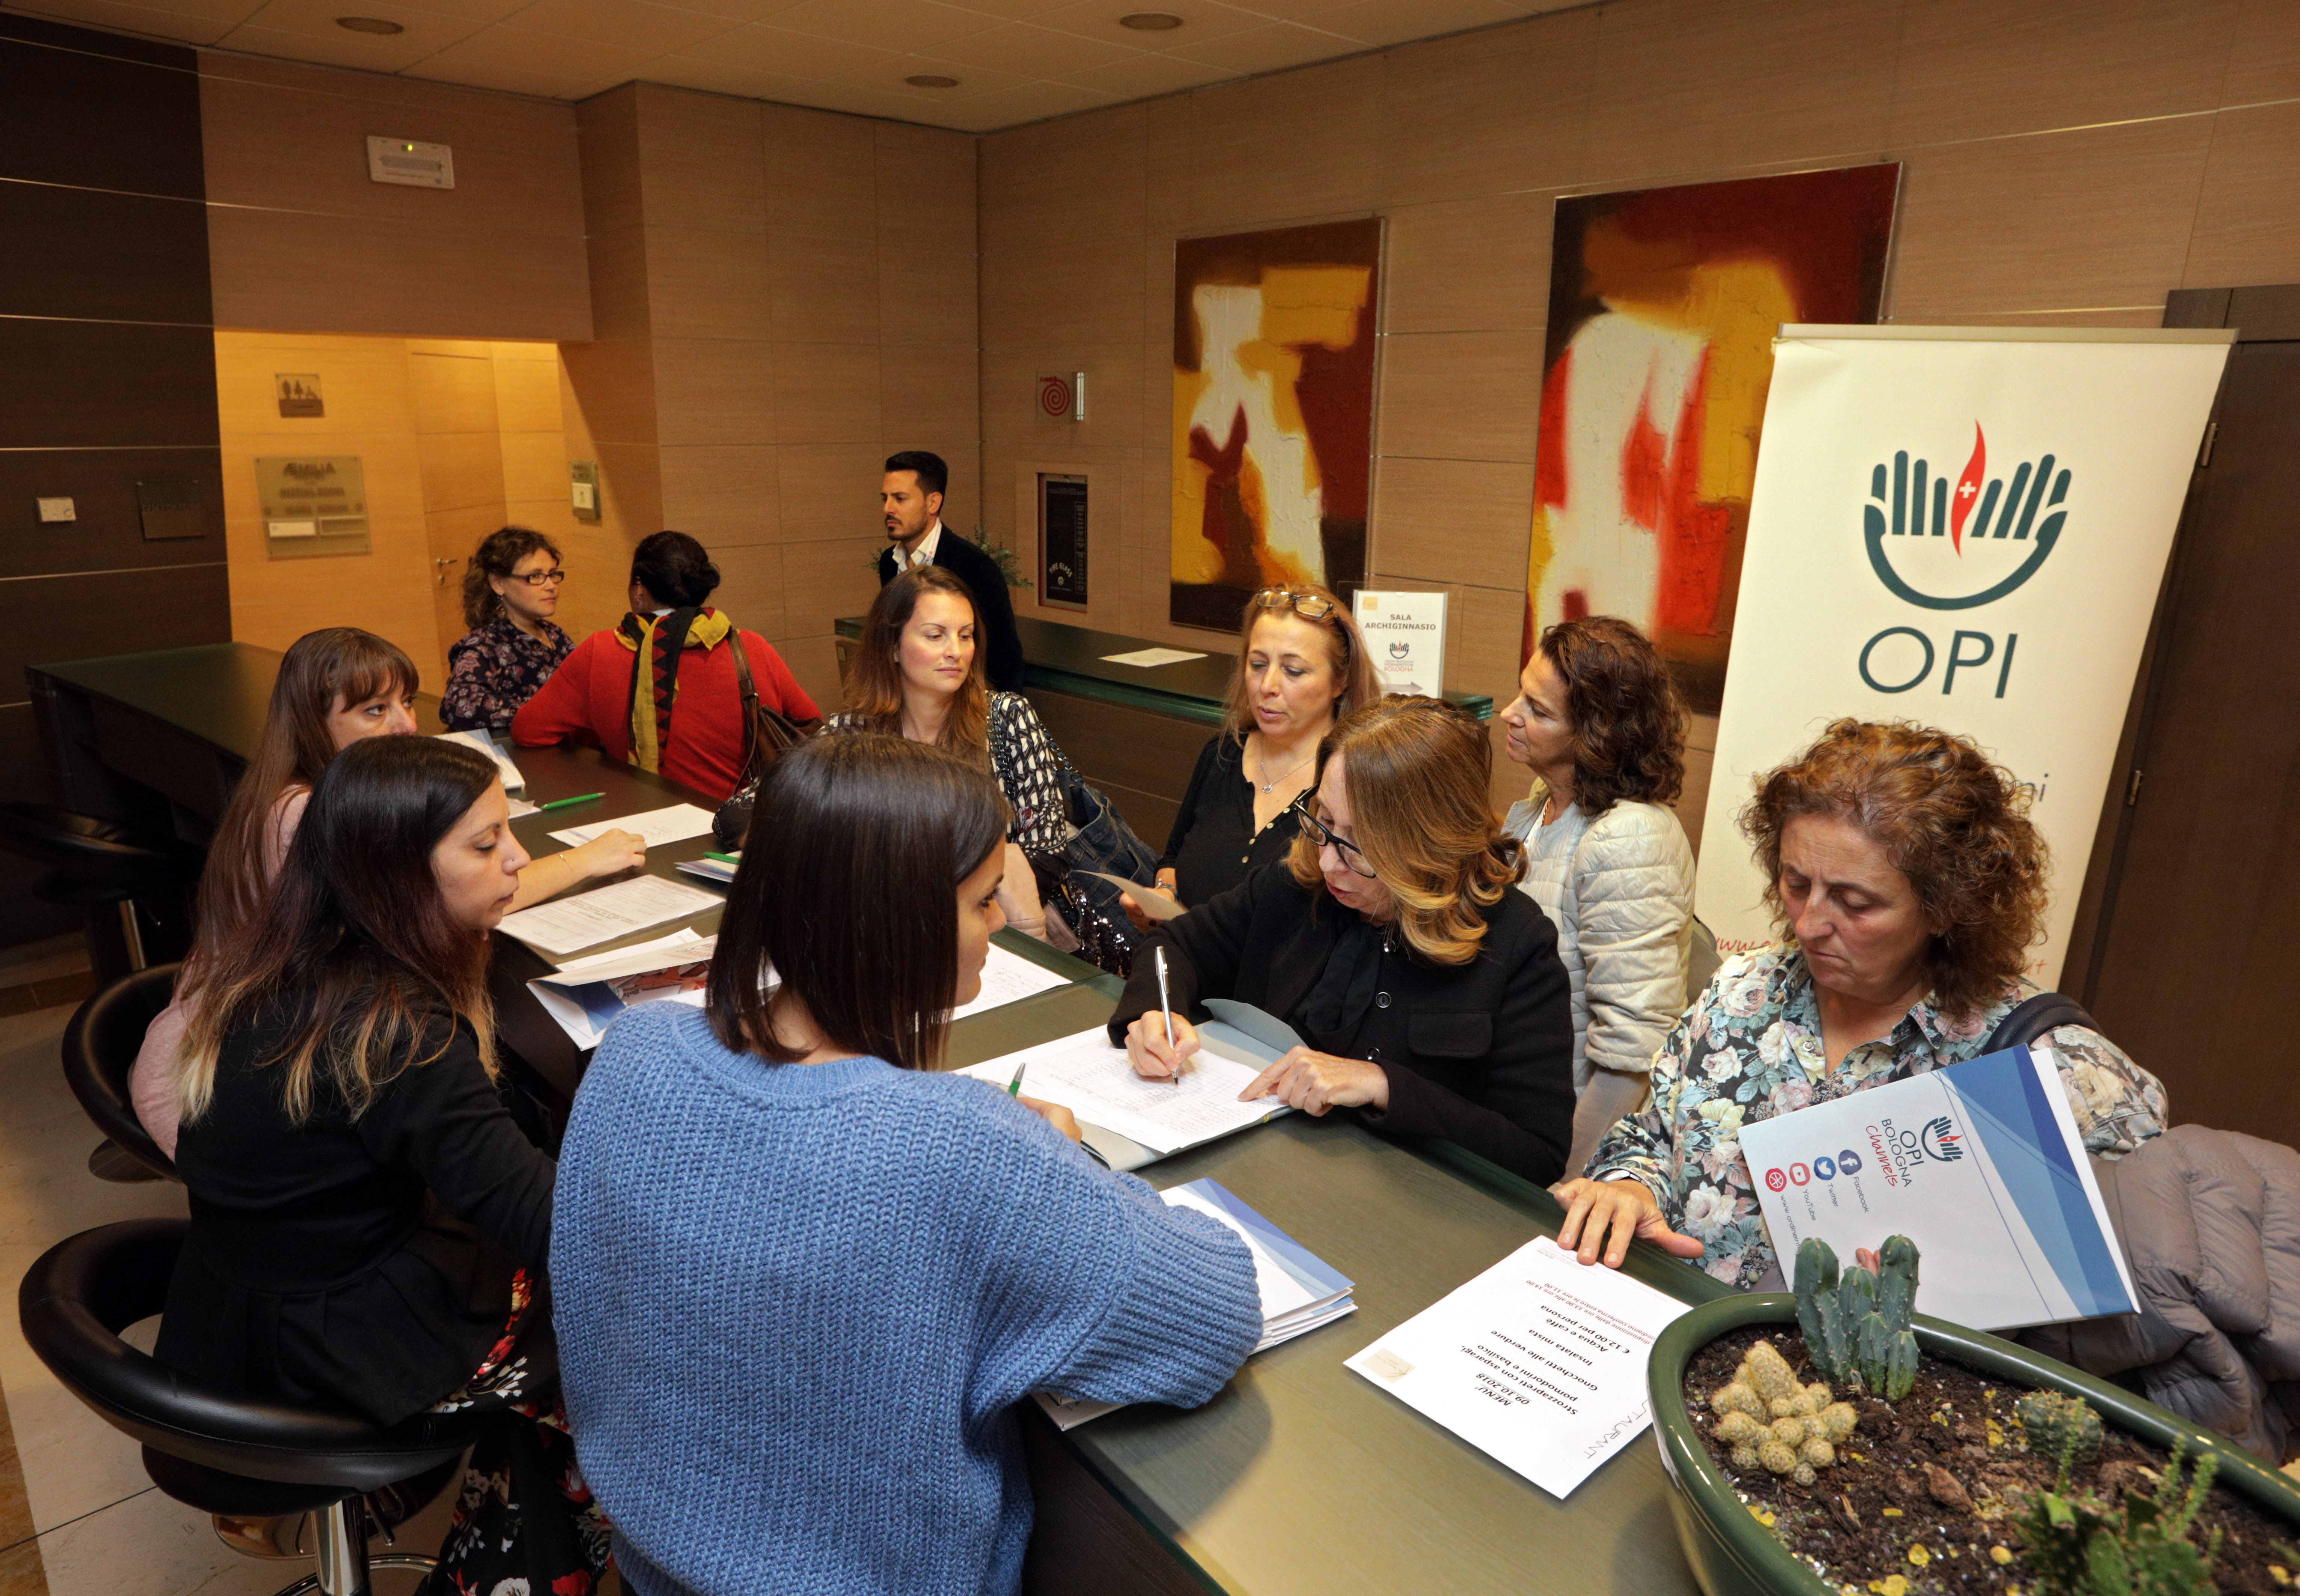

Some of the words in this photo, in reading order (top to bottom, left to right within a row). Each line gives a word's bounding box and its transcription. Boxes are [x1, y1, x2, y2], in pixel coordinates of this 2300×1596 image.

[1059, 562, 1072, 577] GLASS
[1859, 627, 2018, 698] OPI
[1866, 1125, 1898, 1187] Channels
[1882, 1119, 1912, 1187] BOLOGNA
[1900, 1131, 1924, 1166] OPI
[1803, 1189, 1815, 1220] YouTube
[1827, 1183, 1839, 1207] Twitter
[1853, 1177, 1869, 1213] Facebook
[1526, 1280, 1543, 1290] 14.00
[1544, 1283, 1562, 1293] 11.00
[1540, 1305, 1578, 1325] persona
[1565, 1300, 1583, 1311] 13.00
[1580, 1300, 1598, 1311] entro
[1546, 1318, 1569, 1331] caffè
[1595, 1315, 1611, 1324] dalle
[1597, 1309, 1627, 1326] conferma
[1528, 1329, 1554, 1344] mista
[1577, 1325, 1596, 1335] per
[1611, 1323, 1650, 1344] disposizione
[1491, 1331, 1526, 1352] verdure
[1578, 1335, 1608, 1352] Acqua
[1595, 1334, 1622, 1350] 12.00
[1460, 1346, 1500, 1370] asparagi,
[1477, 1345, 1512, 1366] basilico
[1527, 1350, 1545, 1361] alle
[1555, 1344, 1593, 1366] Insalata
[1501, 1369, 1519, 1380] con
[1519, 1369, 1578, 1401] pomodorini
[1544, 1361, 1598, 1391] Gnocchetti
[1475, 1373, 1530, 1404] 09.10.2018
[1518, 1380, 1578, 1415] Strozzapreti
[1584, 1399, 1651, 1459] STAURANT
